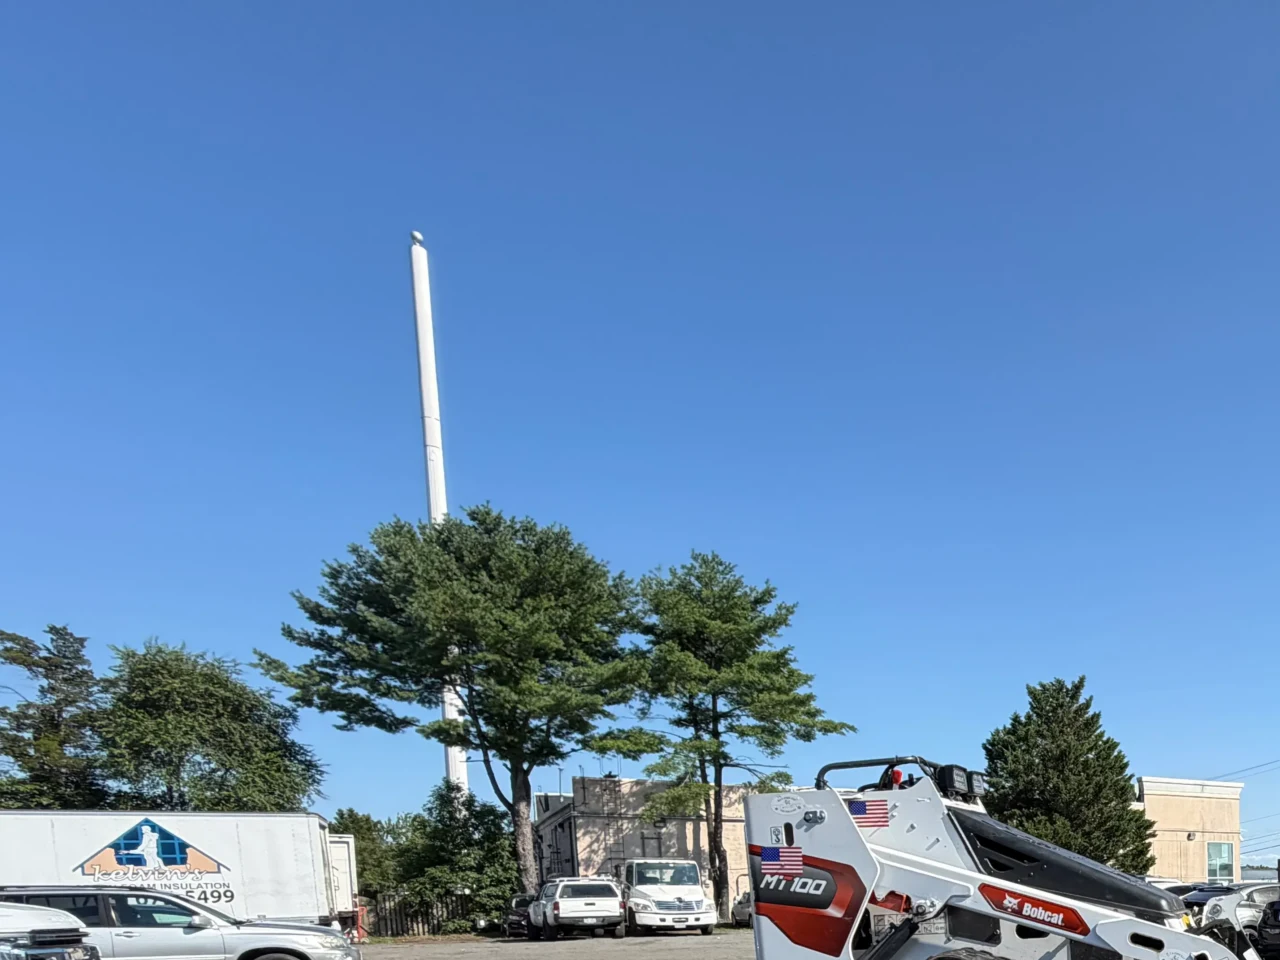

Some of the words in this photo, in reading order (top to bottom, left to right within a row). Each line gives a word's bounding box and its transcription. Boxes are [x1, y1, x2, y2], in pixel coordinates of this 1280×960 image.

[91, 864, 207, 882] kelvin's
[160, 882, 231, 890] INSULATION
[1022, 902, 1064, 926] Bobcat
